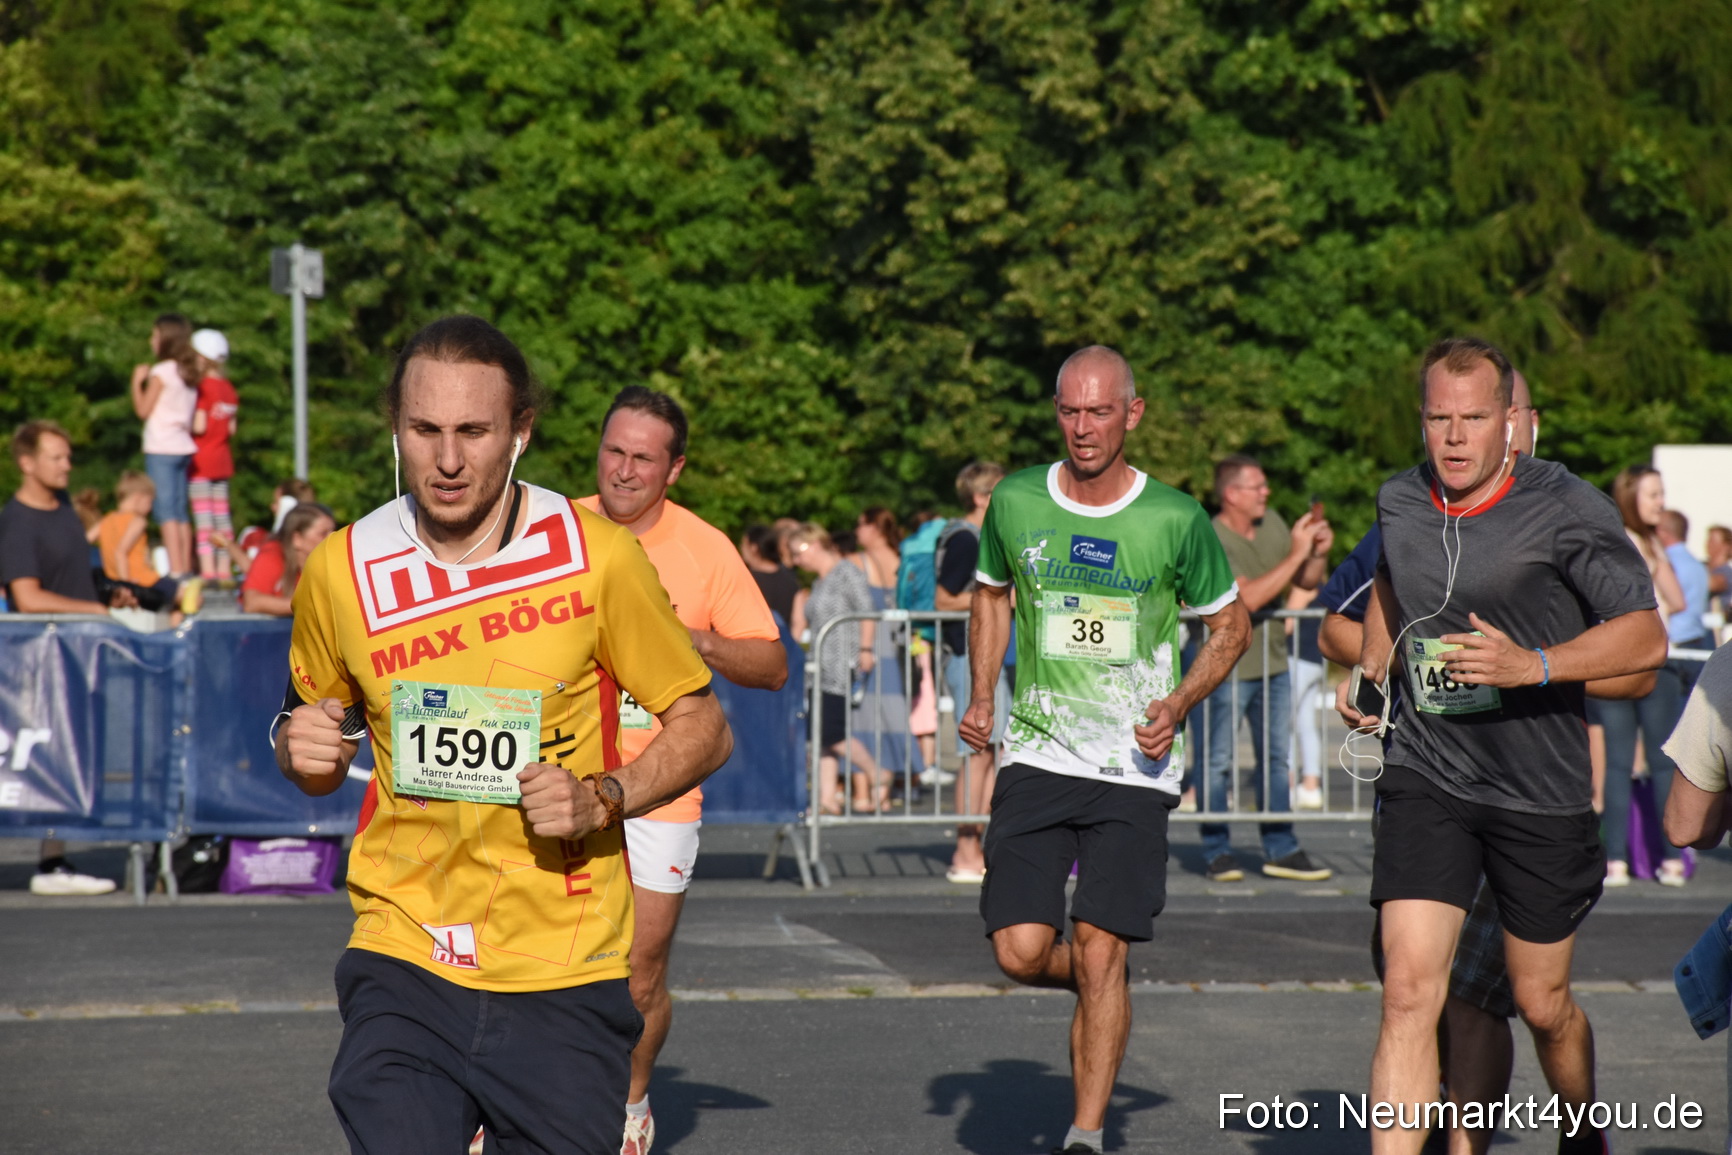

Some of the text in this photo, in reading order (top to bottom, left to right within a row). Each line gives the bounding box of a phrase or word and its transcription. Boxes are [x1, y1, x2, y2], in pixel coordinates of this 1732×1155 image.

[1080, 547, 1113, 560] Fischer
[1045, 557, 1157, 593] firmenlauf
[370, 590, 595, 679] MAX BÖGL
[1072, 618, 1104, 644] 38
[1065, 642, 1112, 653] Barath Georg
[1445, 693, 1473, 701] Jochen
[412, 704, 469, 719] firmenlauf
[502, 720, 530, 730] 2019
[410, 724, 517, 771] 1590
[422, 767, 503, 783] Harrer Andreas
[413, 777, 427, 786] Max
[428, 779, 444, 788] Bögl
[446, 781, 485, 792] Bauservice
[488, 783, 513, 793] GmbH
